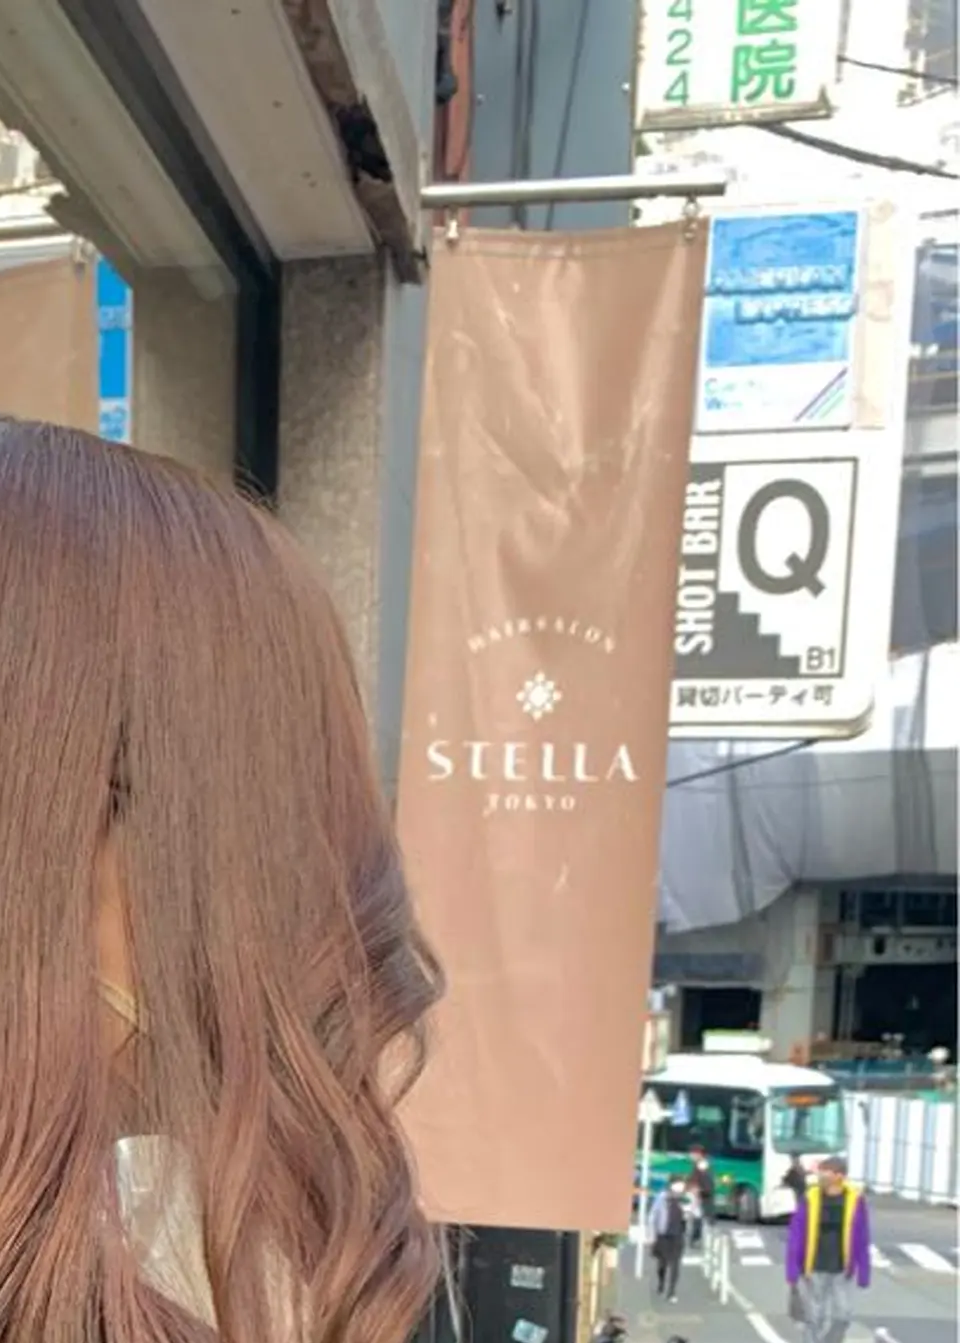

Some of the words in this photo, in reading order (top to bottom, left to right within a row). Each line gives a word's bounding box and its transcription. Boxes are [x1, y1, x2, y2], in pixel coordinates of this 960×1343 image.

[731, 0, 797, 103] 医院
[681, 478, 722, 555] BAR
[737, 478, 831, 598] Q
[674, 564, 717, 655] SHOT
[806, 646, 836, 671] B1
[427, 739, 641, 783] STELLA
[486, 793, 577, 812] TOKYO
